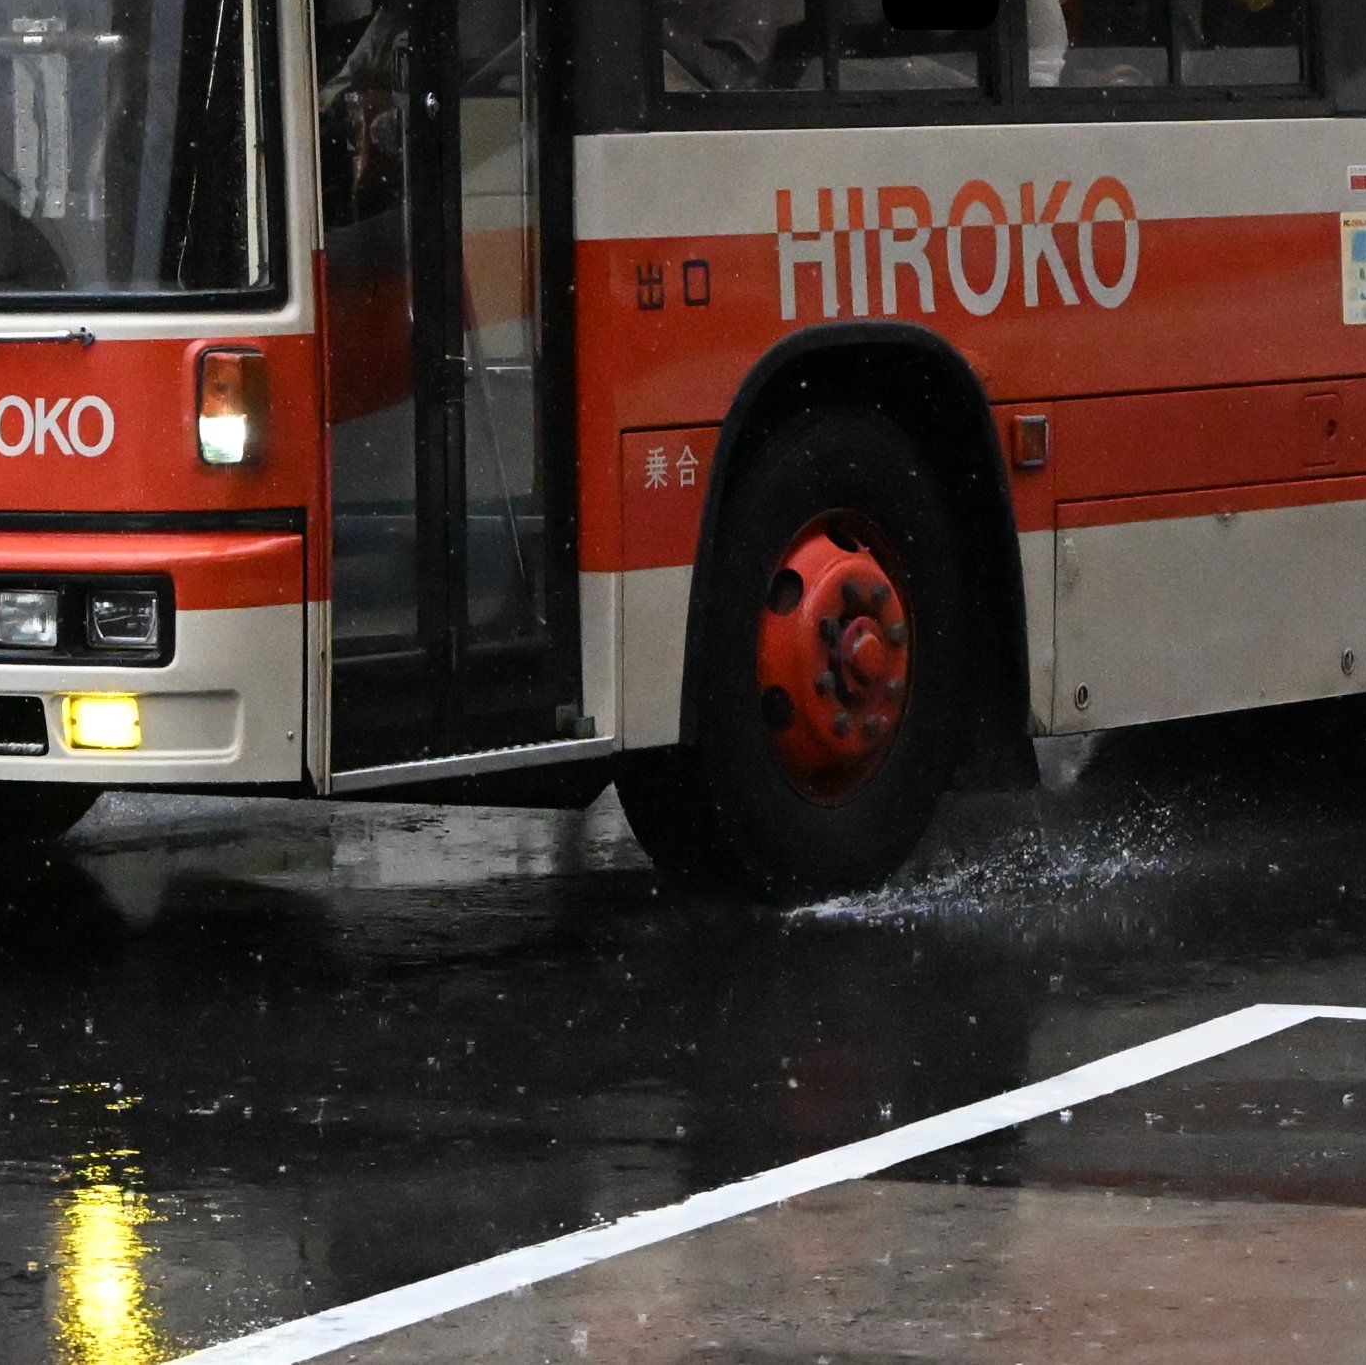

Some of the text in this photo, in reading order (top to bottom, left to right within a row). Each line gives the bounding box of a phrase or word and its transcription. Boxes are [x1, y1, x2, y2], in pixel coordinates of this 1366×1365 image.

[775, 174, 1140, 321] HIROKO
[635, 258, 712, 312] 出口
[644, 445, 700, 489] 乗合
